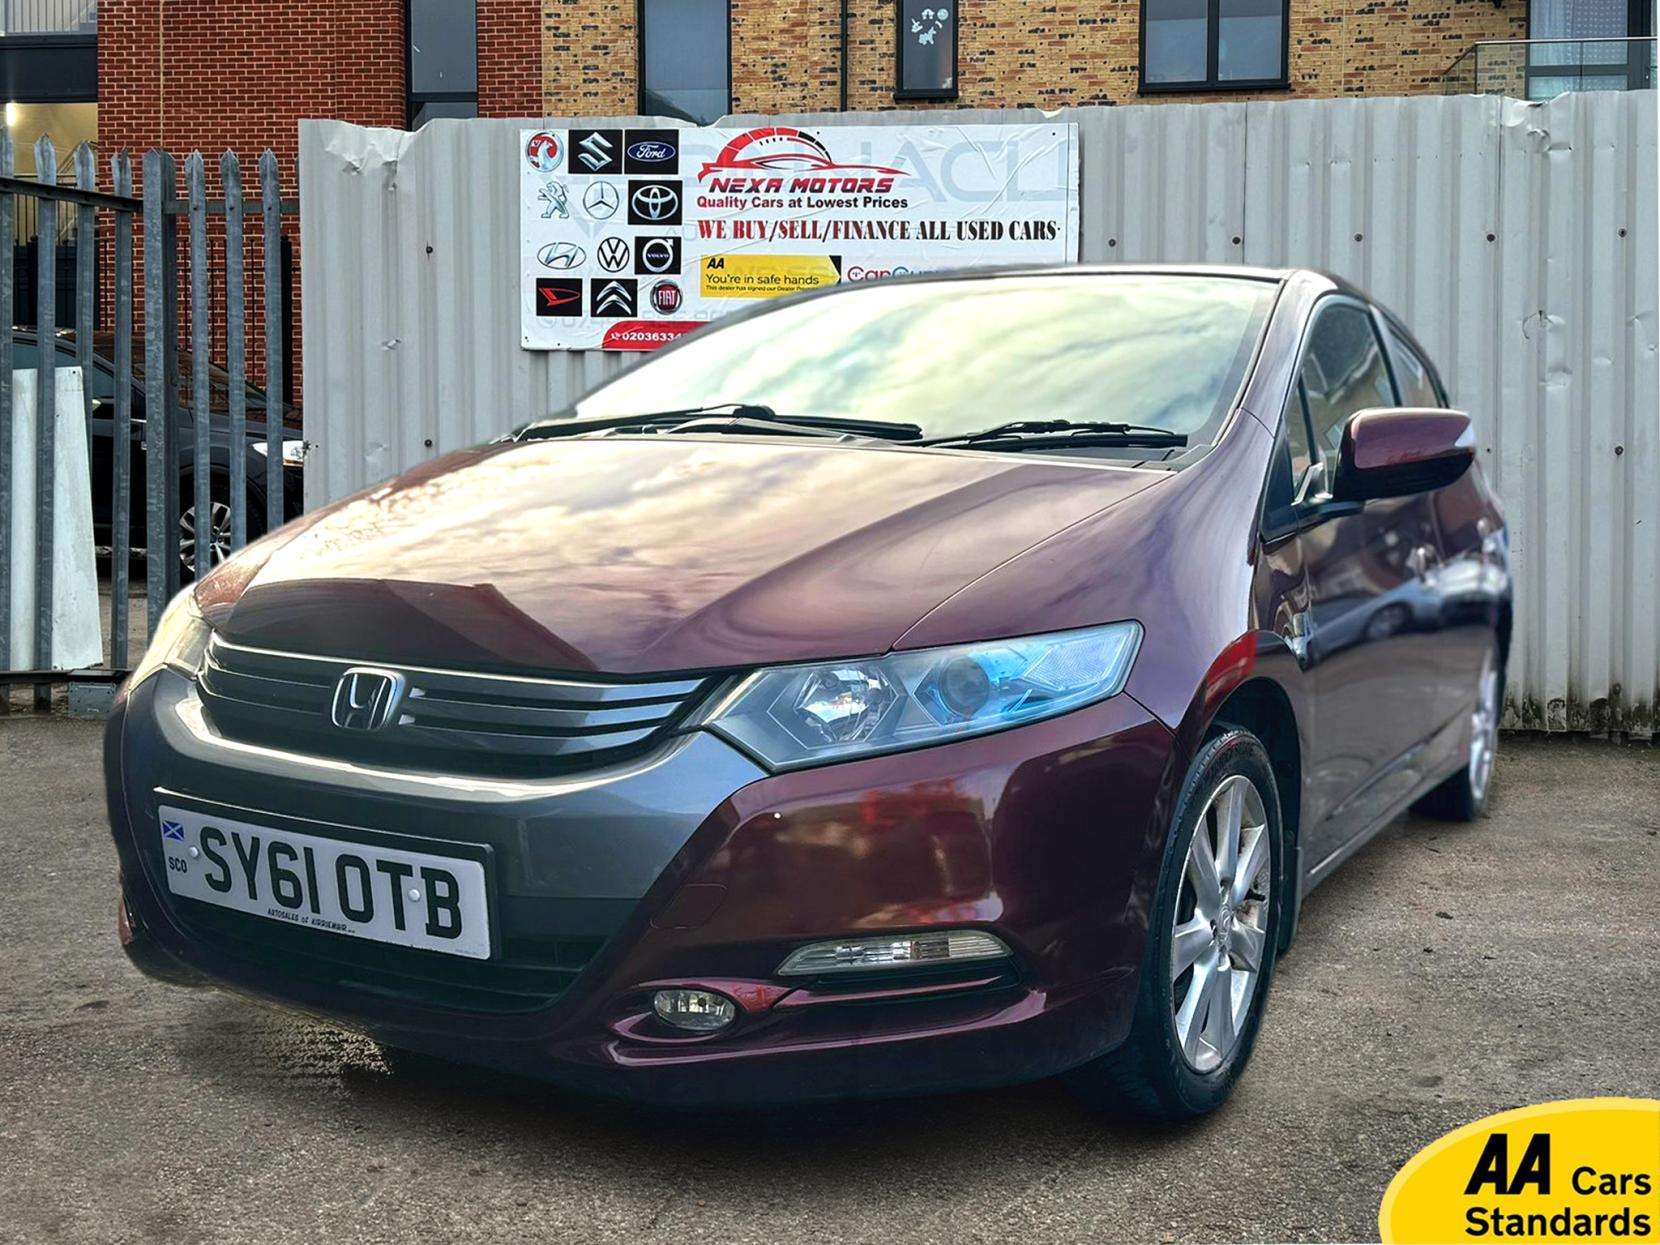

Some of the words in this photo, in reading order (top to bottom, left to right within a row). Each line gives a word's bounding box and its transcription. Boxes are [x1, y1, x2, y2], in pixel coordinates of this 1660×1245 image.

[636, 144, 666, 159] Ford
[709, 178, 783, 193] NEXA
[789, 178, 894, 193] MOTORS
[697, 197, 746, 209] Quality
[752, 197, 784, 208] Cars
[788, 198, 803, 208] at
[807, 197, 859, 208] Lowest
[863, 196, 908, 208] Prices
[697, 220, 727, 240] WE
[733, 220, 910, 242] BUY/SELL/FINANCE
[916, 221, 950, 240] ALL
[956, 221, 1003, 240] USED
[707, 257, 725, 269] AA
[706, 273, 741, 284] You're
[744, 273, 754, 284] in
[757, 274, 781, 284] safe
[784, 275, 819, 285] hands
[658, 290, 676, 306] FIAT
[168, 856, 188, 874] SCO
[199, 826, 321, 915] SY61
[335, 853, 463, 940] OTB
